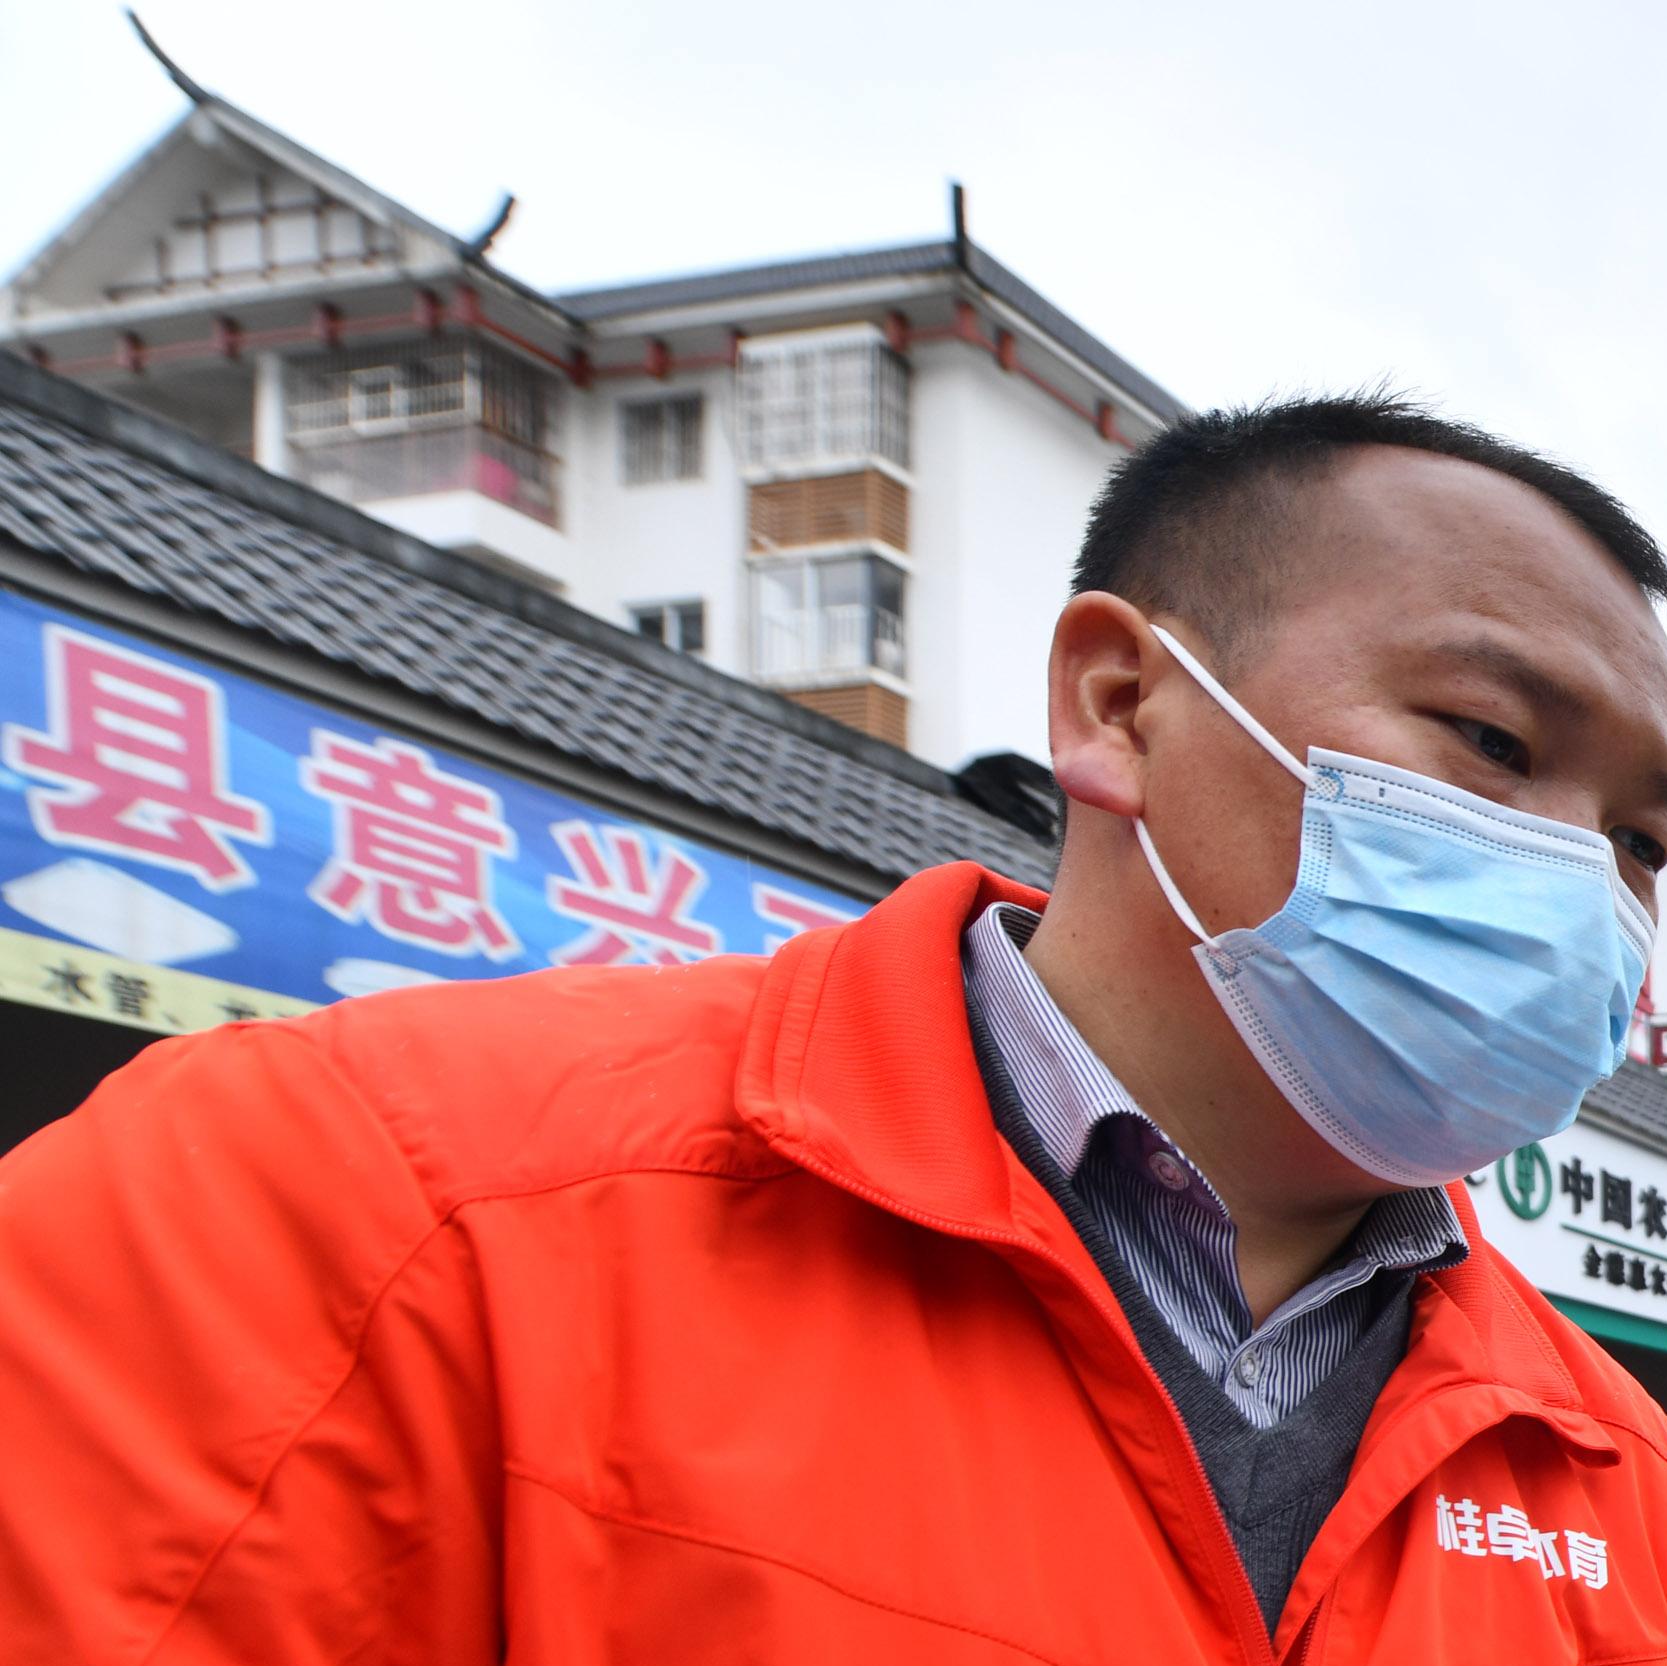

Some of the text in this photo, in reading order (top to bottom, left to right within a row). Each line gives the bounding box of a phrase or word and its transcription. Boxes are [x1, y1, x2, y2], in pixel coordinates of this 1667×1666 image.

[4, 621, 868, 966] 县意兴
[40, 958, 290, 1028] 水管、
